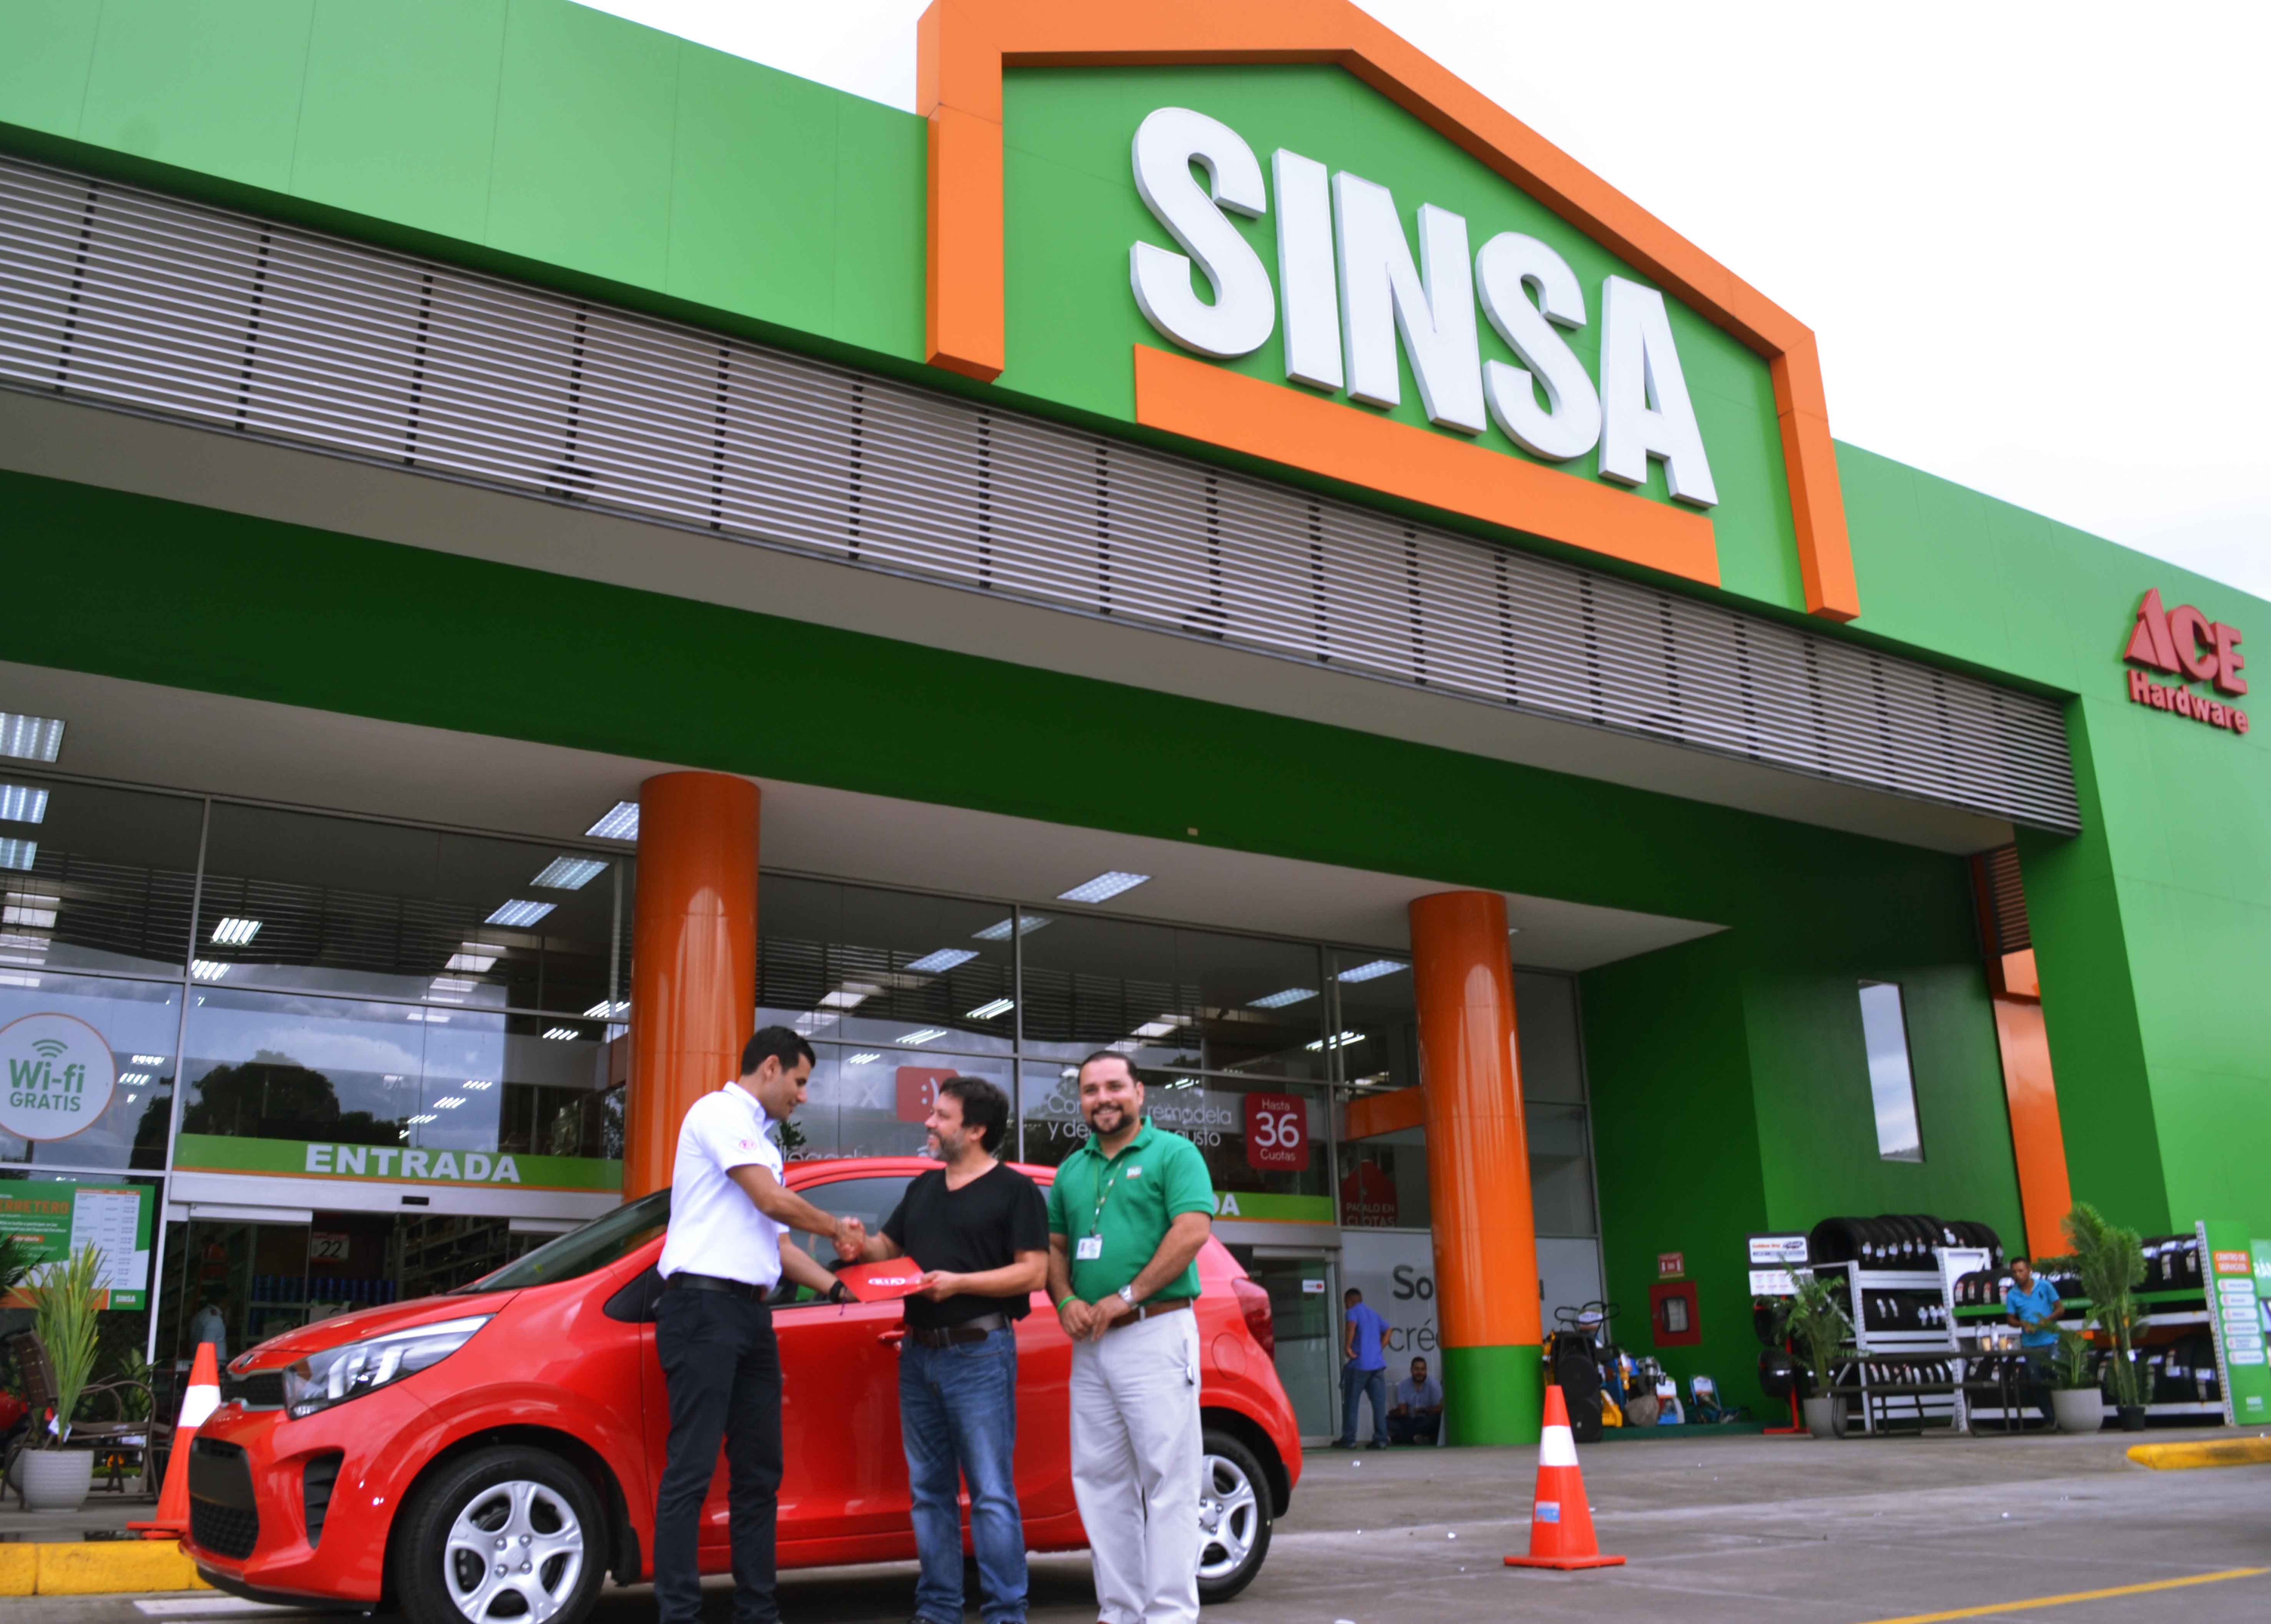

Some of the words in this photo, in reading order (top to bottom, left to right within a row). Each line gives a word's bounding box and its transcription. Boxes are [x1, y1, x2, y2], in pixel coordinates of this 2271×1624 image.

[1130, 107, 1718, 509] SINSA
[2123, 587, 2248, 697] ACE
[2126, 668, 2249, 734] Hardware
[9, 1058, 86, 1093] Wi-fi
[10, 1091, 81, 1112] GRATIS
[1147, 1104, 1232, 1124] remodela
[1262, 1098, 1290, 1111] Hasta
[1047, 1122, 1059, 1141] y
[1063, 1119, 1092, 1139] de
[1255, 1111, 1300, 1148] 36
[305, 1144, 520, 1183] ENTRADA
[1260, 1147, 1296, 1162] Cuotas
[319, 1240, 343, 1258] 22
[1388, 1318, 1441, 1353] cré
